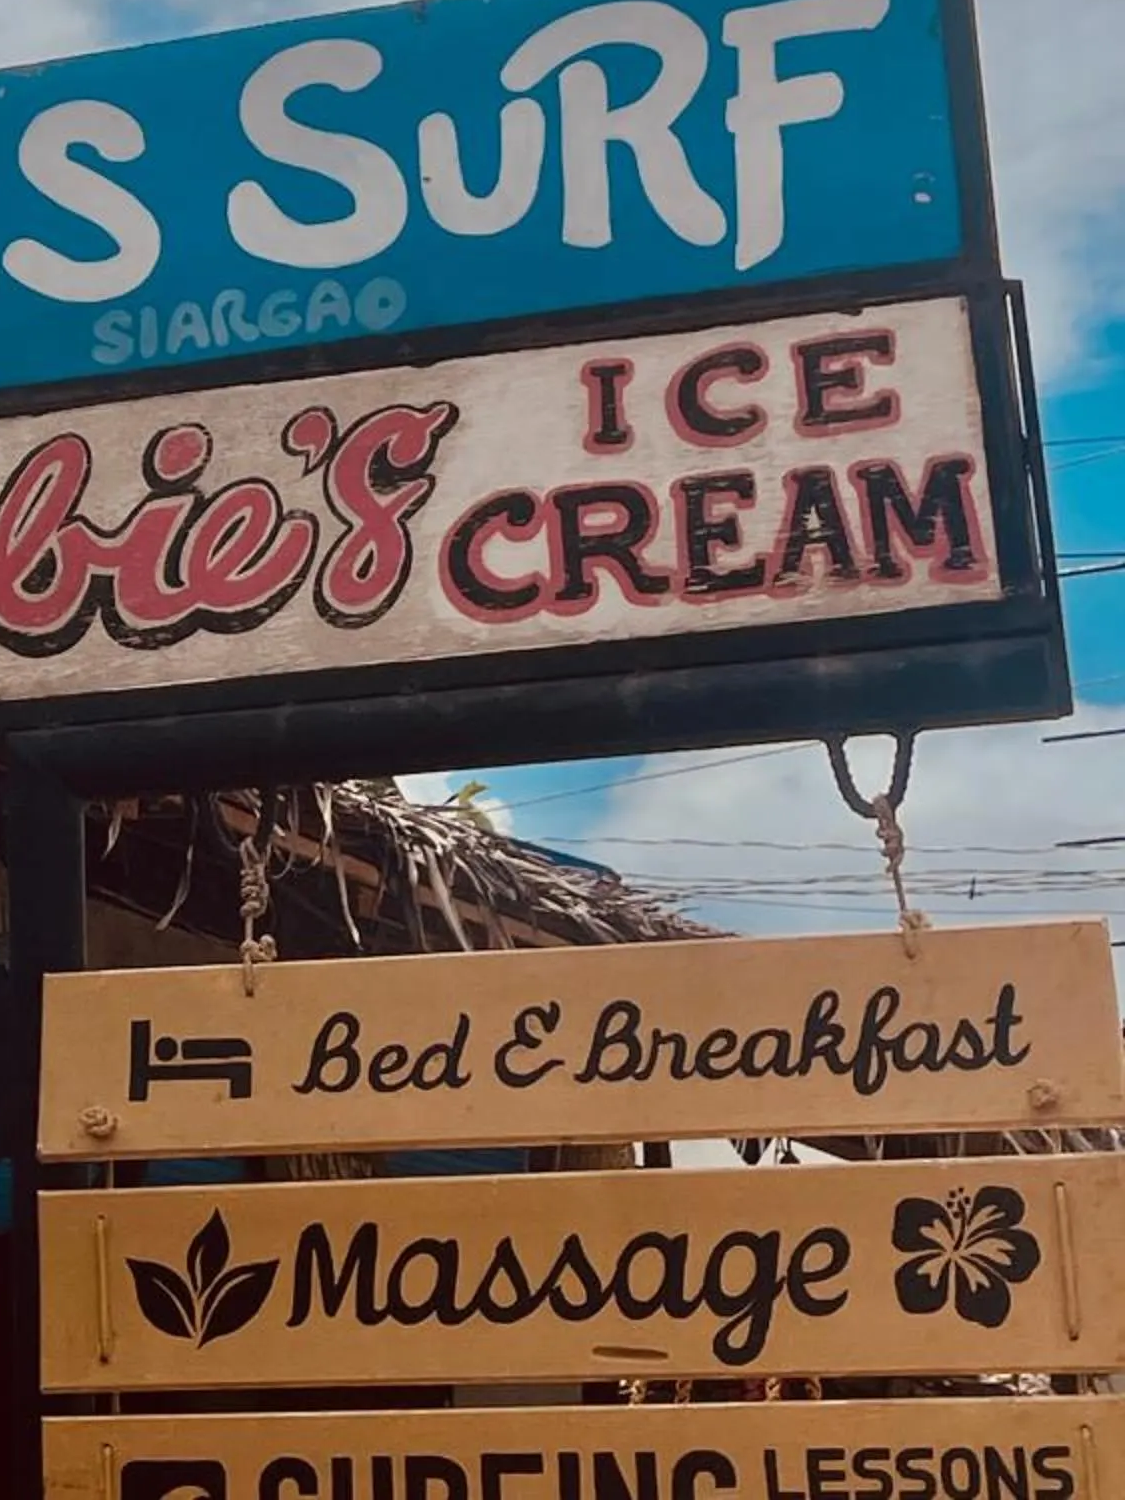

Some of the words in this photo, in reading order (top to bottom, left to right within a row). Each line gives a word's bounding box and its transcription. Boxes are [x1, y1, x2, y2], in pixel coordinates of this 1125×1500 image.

[91, 277, 408, 365] SIARGAO
[580, 328, 901, 455] ICE
[438, 451, 989, 624] CREAM
[290, 1009, 474, 1095] Bed
[573, 981, 1033, 1097] Breakfast
[285, 1219, 852, 1367] Massage
[763, 1445, 1075, 1500] LESSONS
